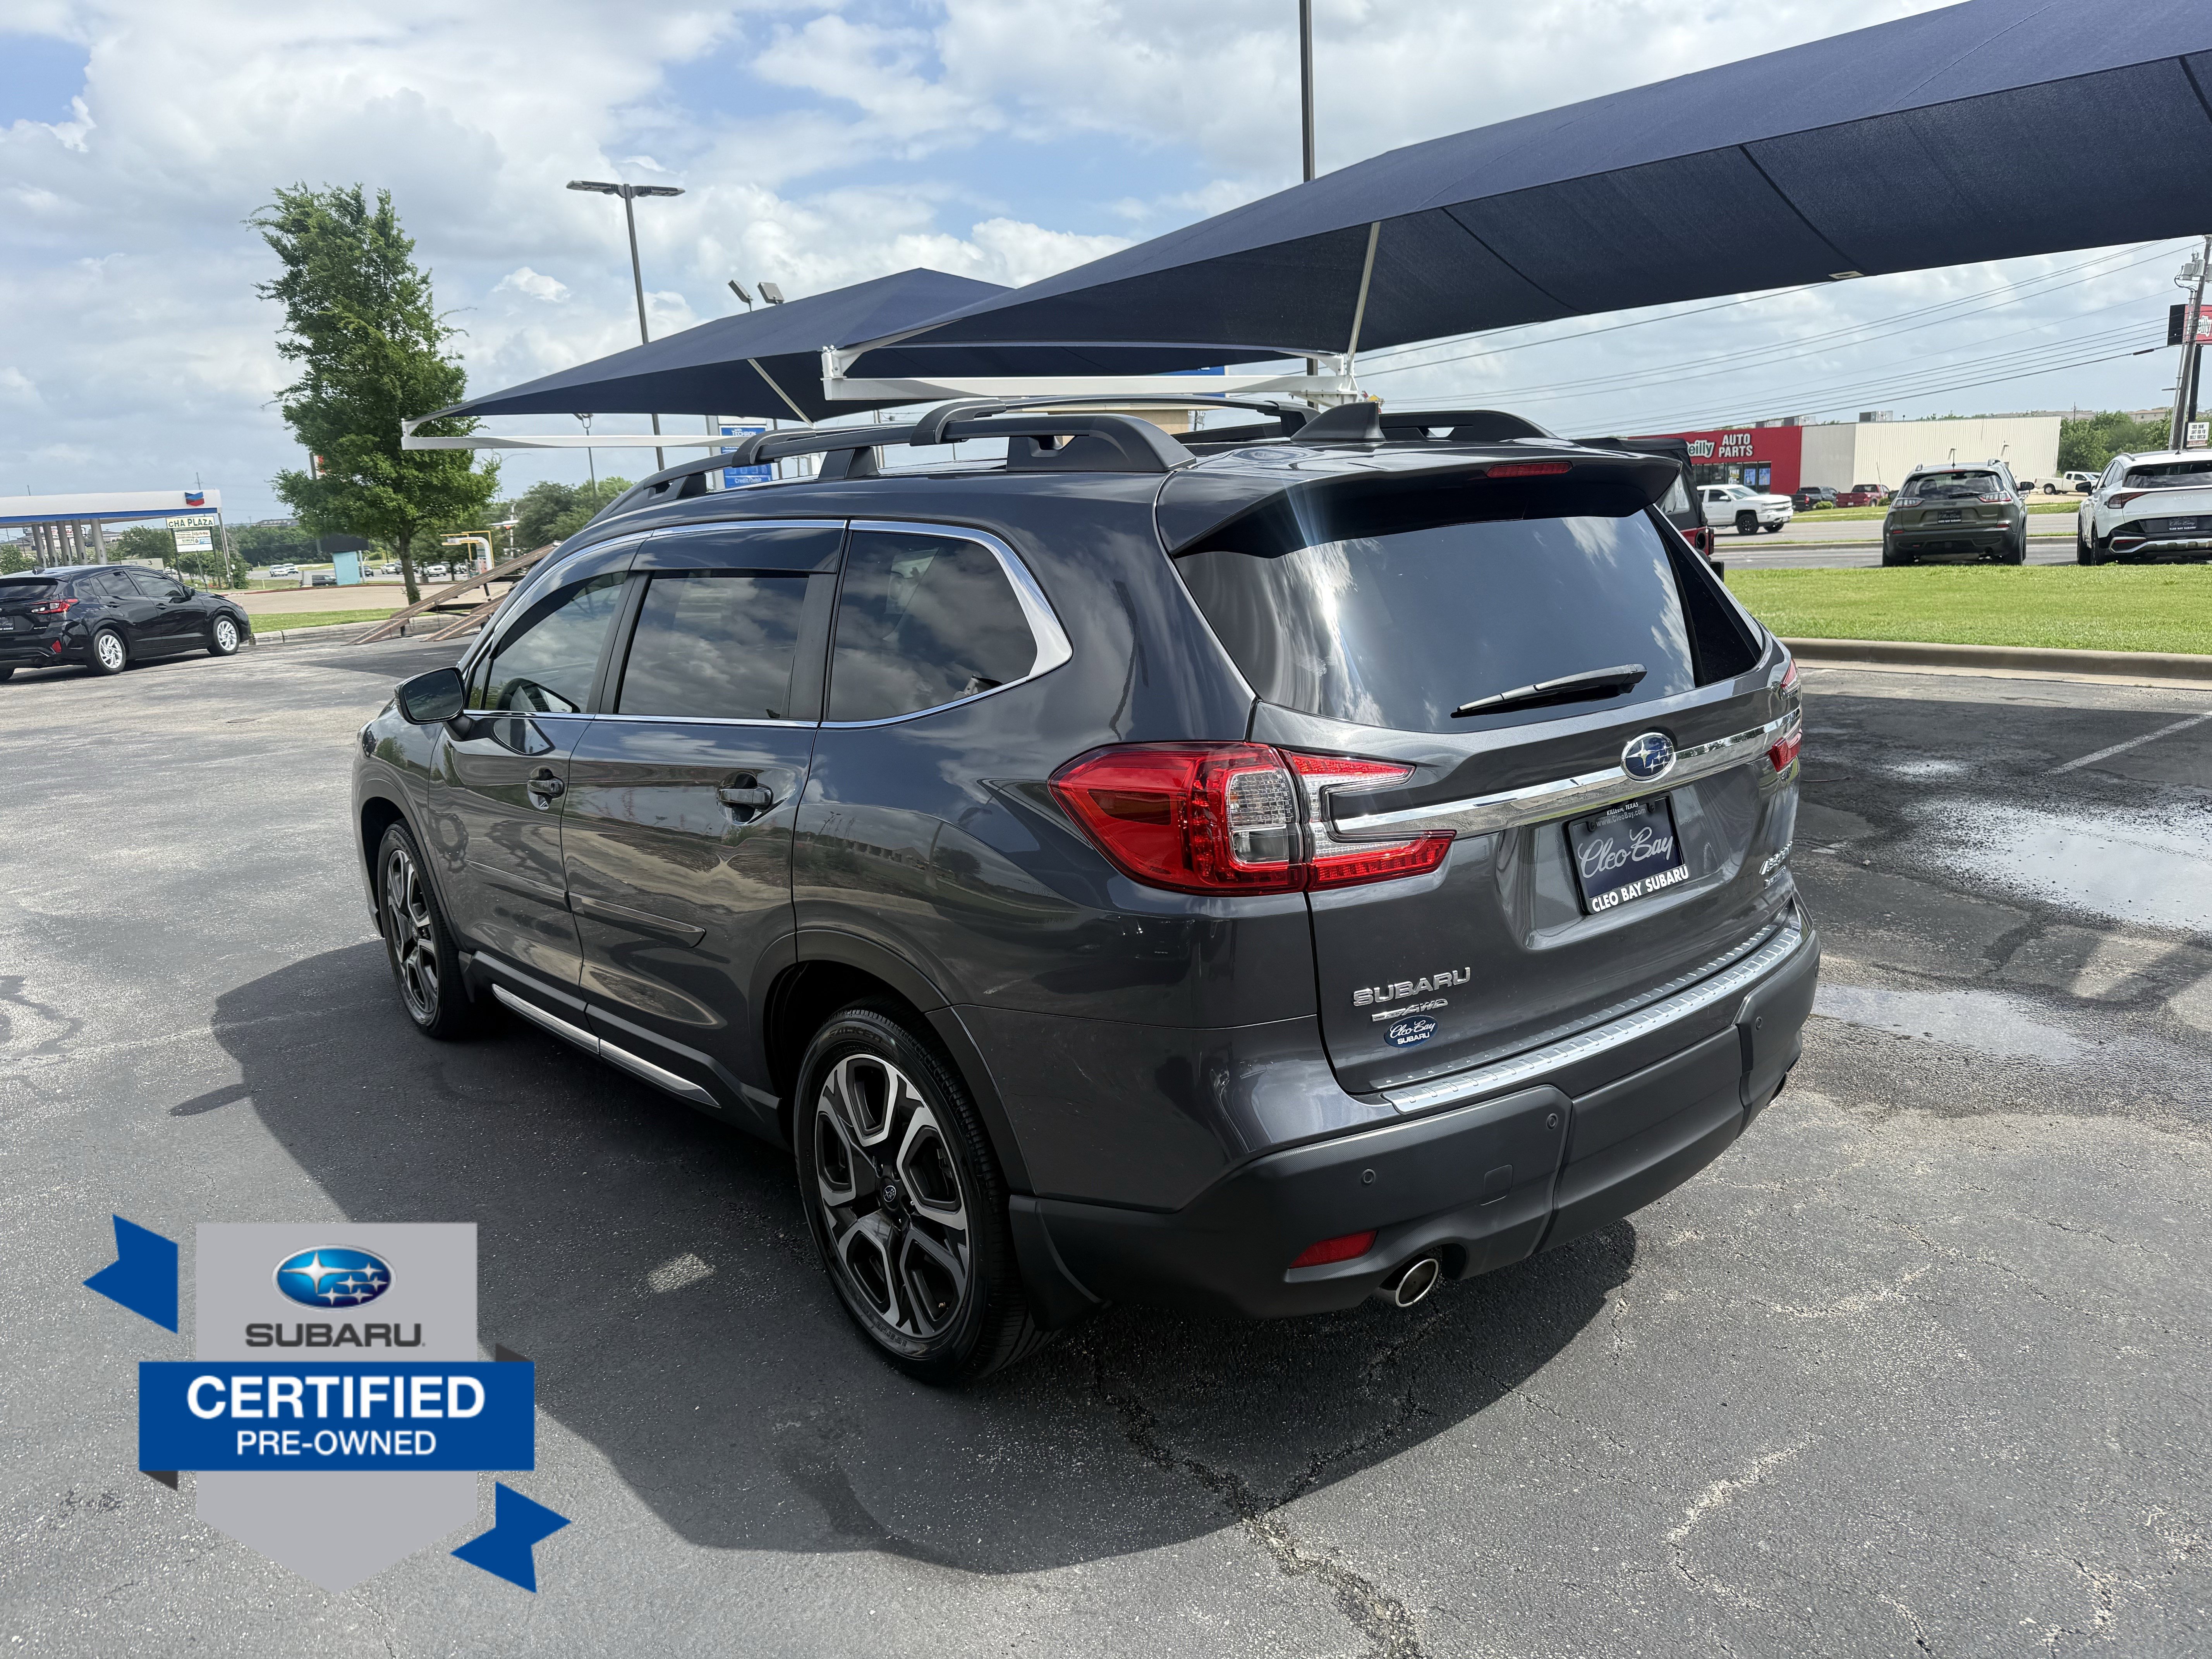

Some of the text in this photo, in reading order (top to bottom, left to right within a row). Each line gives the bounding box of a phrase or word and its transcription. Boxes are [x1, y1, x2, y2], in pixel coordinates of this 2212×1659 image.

[2197, 315, 2212, 337] eilly
[1722, 433, 1751, 446] AUTO
[1687, 440, 1715, 459] eilly
[1718, 445, 1753, 458] PARTS
[168, 518, 213, 527] CHA PLAZA
[1625, 802, 1638, 810] TEXAS
[1596, 808, 1646, 827] www.CleoBay.com
[1577, 826, 1673, 878] Cleo Bay
[1592, 865, 1689, 912] CLEO BAY SUBARU
[1353, 967, 1470, 1006] SUBARU
[1401, 998, 1448, 1016] AWD
[1390, 1020, 1436, 1039] Cleo Bay
[1397, 1032, 1430, 1045] SUBARU
